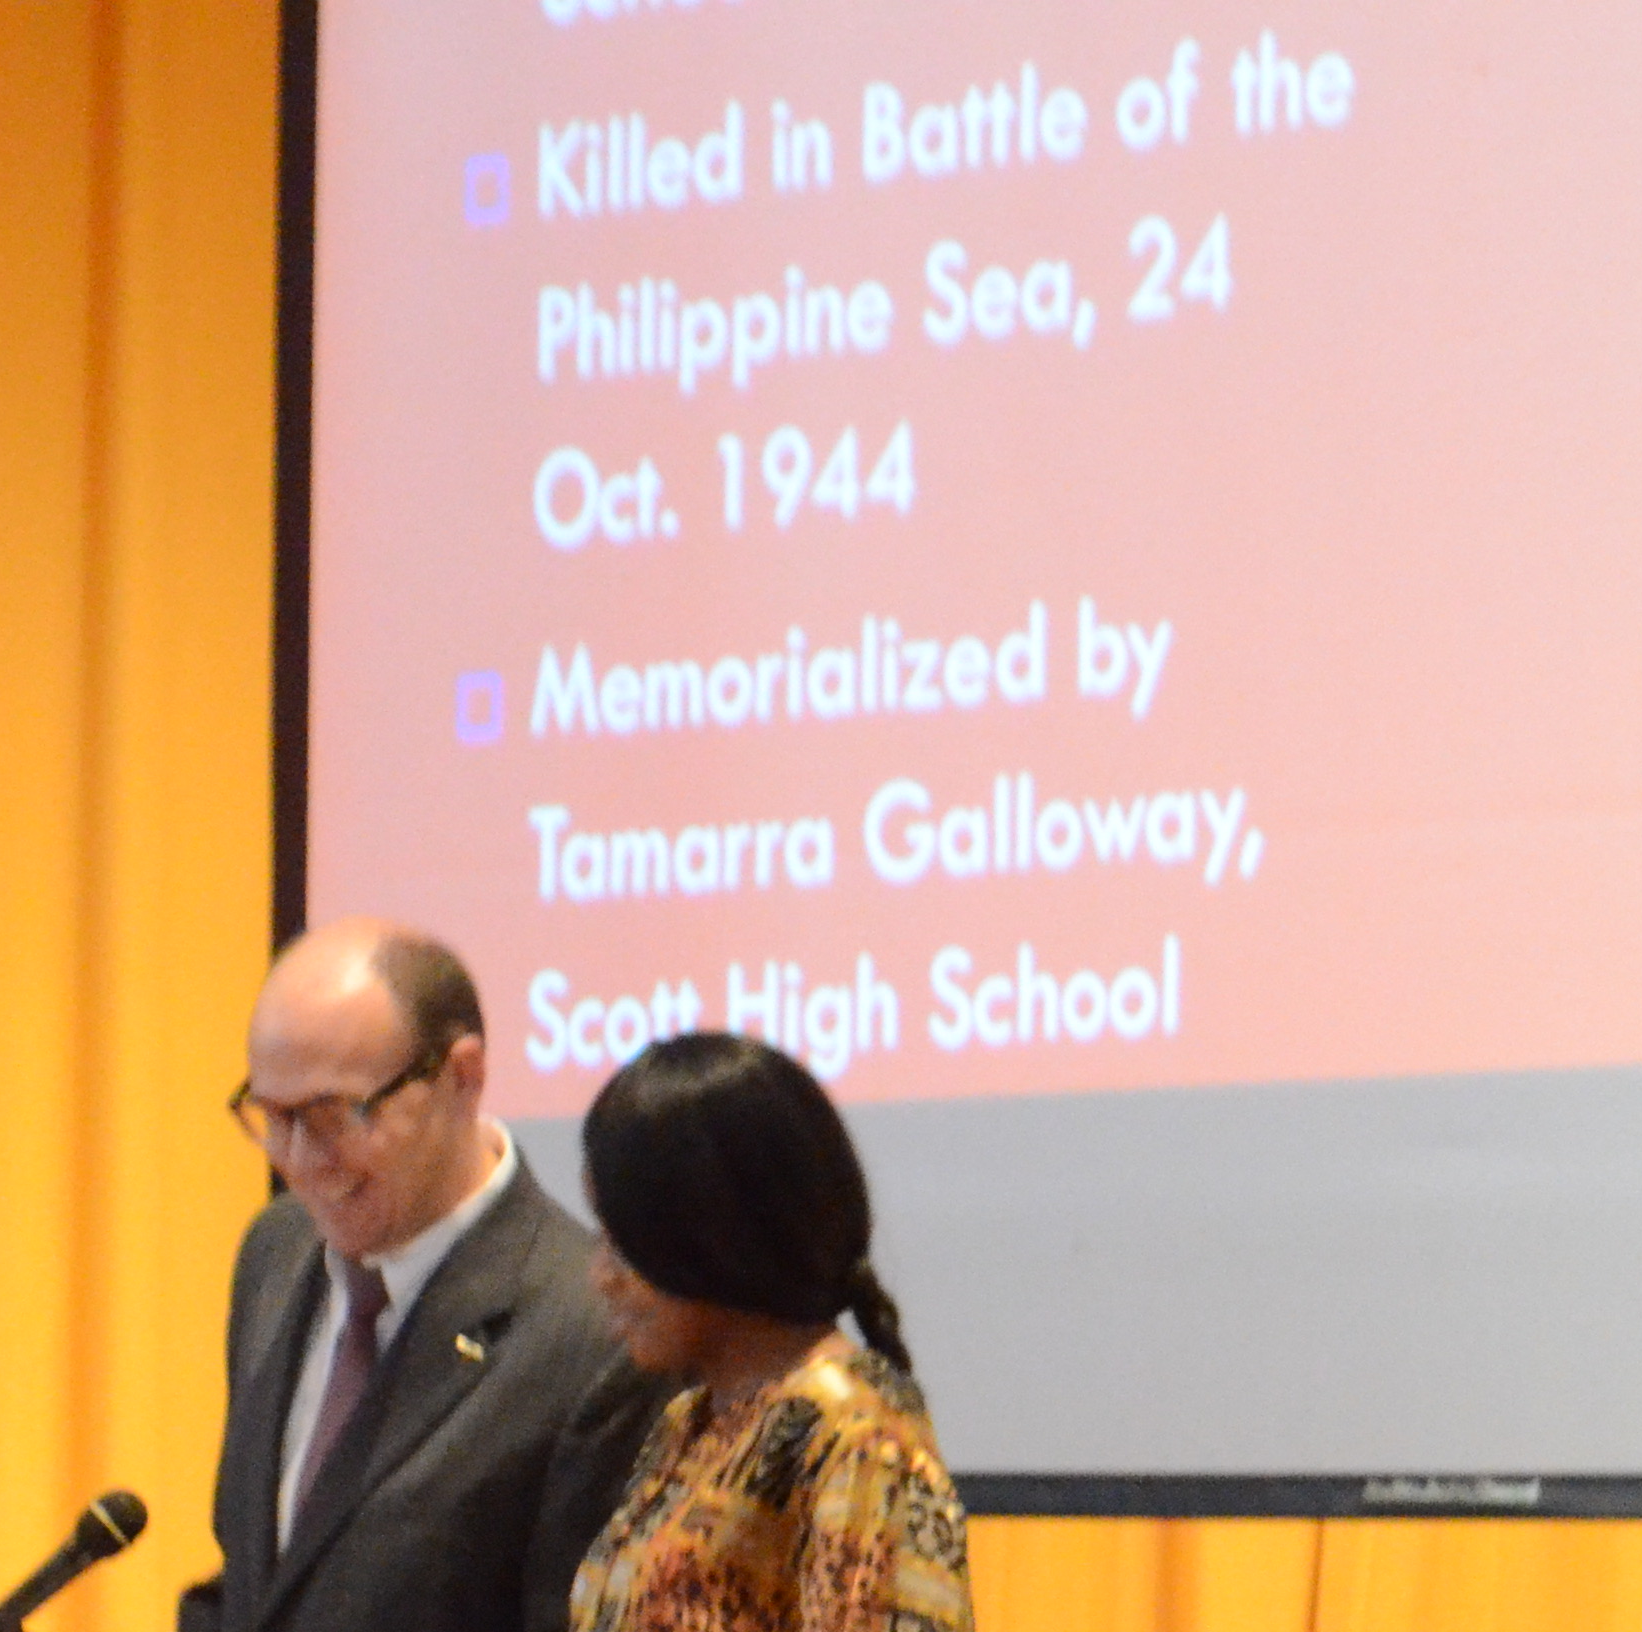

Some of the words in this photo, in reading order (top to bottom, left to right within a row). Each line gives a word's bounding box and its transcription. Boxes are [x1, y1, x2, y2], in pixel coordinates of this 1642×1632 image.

[538, 100, 744, 218] Killed
[770, 101, 834, 193] in
[862, 61, 1087, 184] Battle
[1116, 36, 1200, 147] of
[1231, 31, 1355, 137] the
[537, 267, 893, 394] Philippine
[924, 239, 1097, 348] Sea,
[1127, 213, 1233, 322] 24
[533, 447, 680, 549] Oct.
[719, 419, 916, 530] 1944
[529, 600, 1048, 738] Memorialized
[1077, 596, 1172, 719] by
[530, 805, 834, 903] Tamarra
[863, 772, 1264, 886] Galloway,
[526, 965, 702, 1073] Scott
[727, 952, 897, 1080] High
[929, 933, 1179, 1051] School
